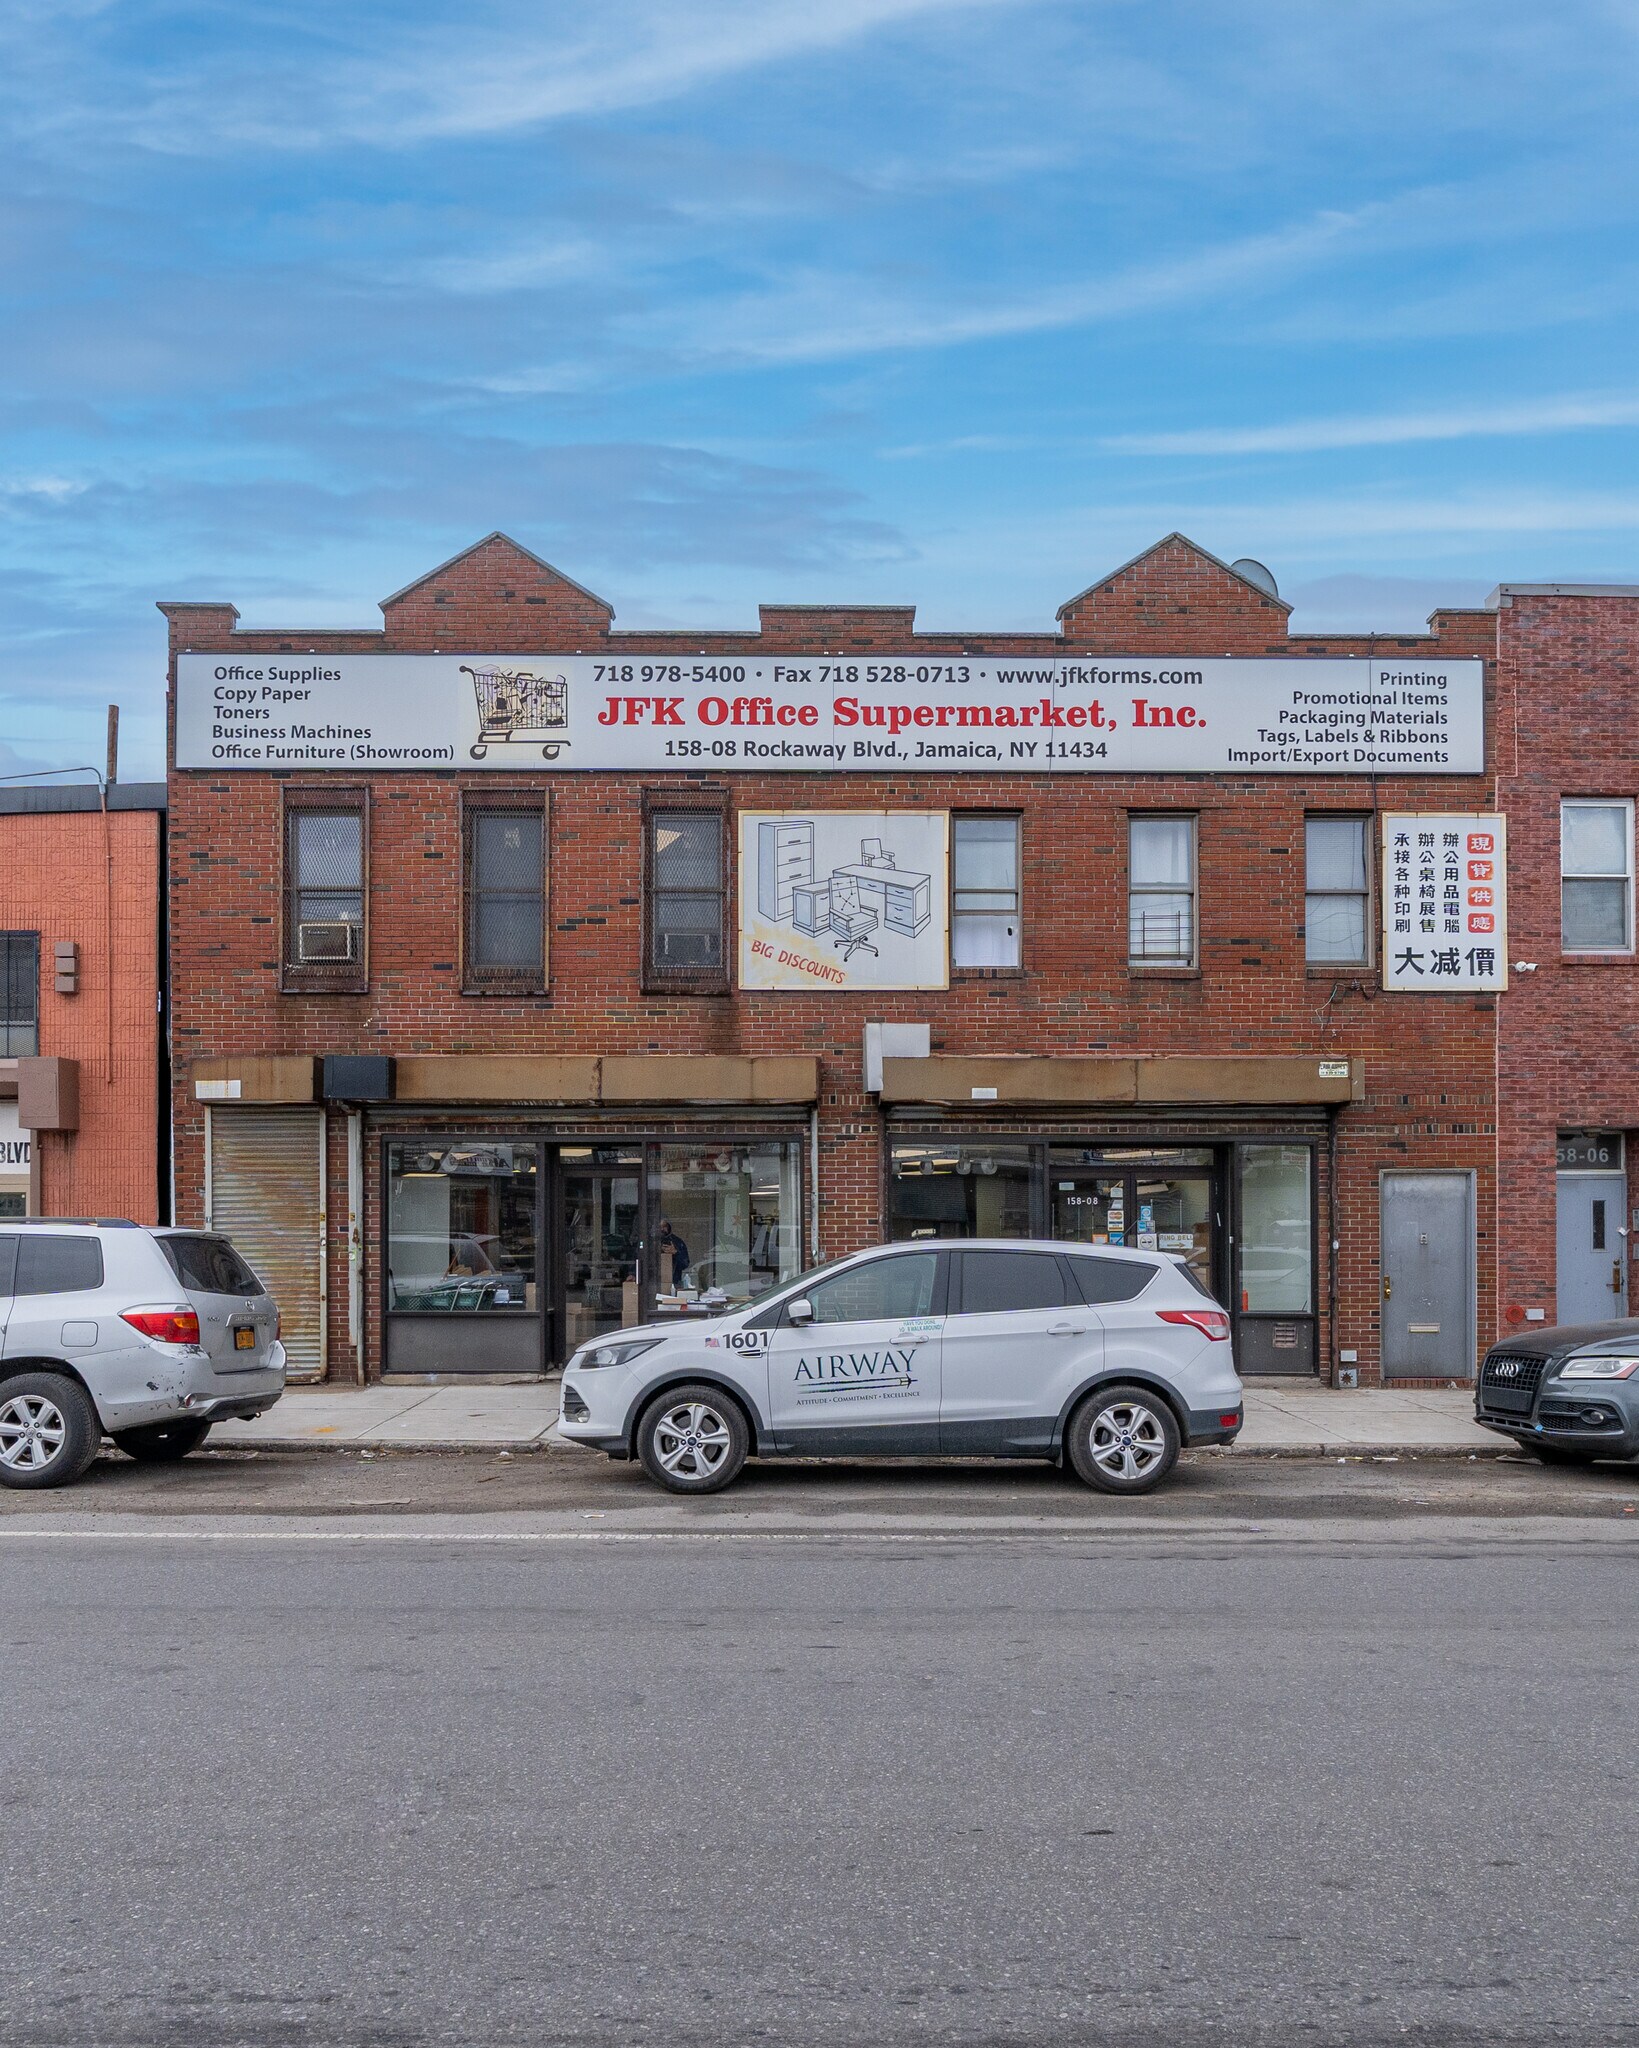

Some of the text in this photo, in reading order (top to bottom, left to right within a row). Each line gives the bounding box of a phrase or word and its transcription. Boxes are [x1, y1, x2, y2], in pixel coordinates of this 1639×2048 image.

[214, 666, 341, 684] Office Supplies
[594, 665, 1203, 684] 718 978-5400 Fax 718 528-0713 www.jfkforms.com
[1381, 672, 1448, 689] Printing
[214, 687, 311, 703] Copy Paper
[1294, 691, 1447, 706] Promotional Items
[213, 706, 269, 719] Toners
[598, 697, 1206, 734] JFK Office Supermarket, Inc.
[1280, 710, 1448, 727] Packaging Materials
[213, 725, 371, 738] Business Machines
[1257, 727, 1448, 746] Tags, Labels & Ribbons
[212, 744, 453, 760] Office Furniture (Showroom)
[666, 740, 1108, 761] 158-08 Rockaway Blvd., Jamaica, NY 11434
[1229, 748, 1449, 765] Import/Export Documents
[751, 939, 846, 984] BIG DISCOUNTS
[1067, 1197, 1098, 1205] 158-08
[723, 1332, 768, 1349] 1601
[794, 1349, 917, 1381] AIRWAY
